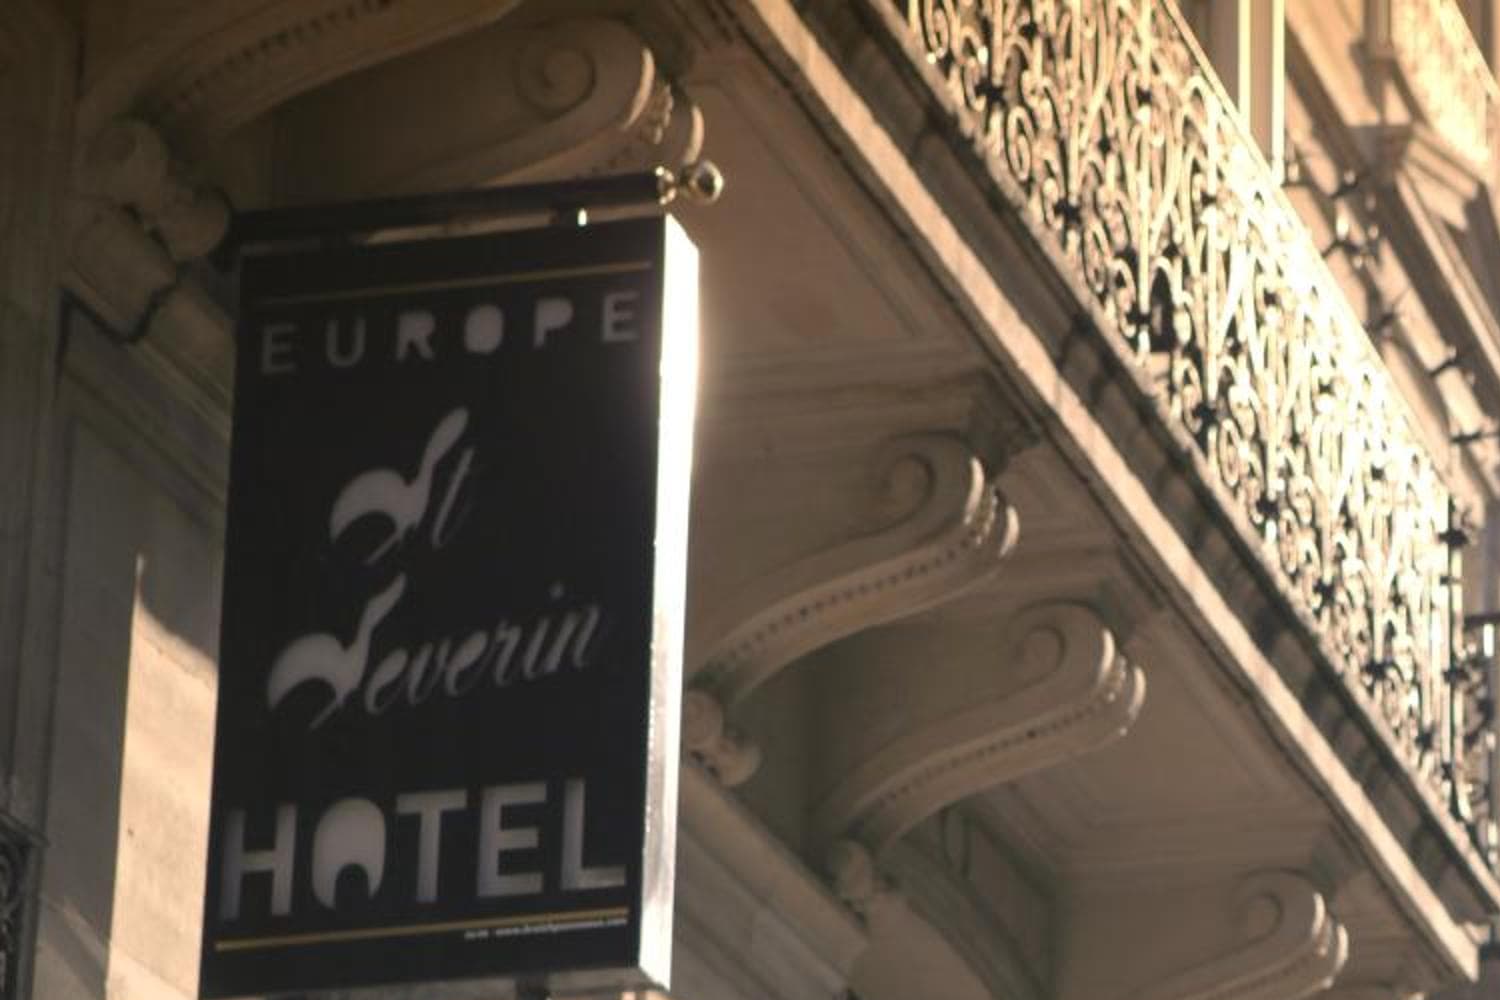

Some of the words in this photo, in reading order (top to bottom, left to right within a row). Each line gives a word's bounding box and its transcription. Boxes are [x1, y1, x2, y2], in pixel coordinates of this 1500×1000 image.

[261, 291, 640, 374] EUROPE
[267, 571, 600, 729] Severin
[219, 779, 627, 922] HOTEL
